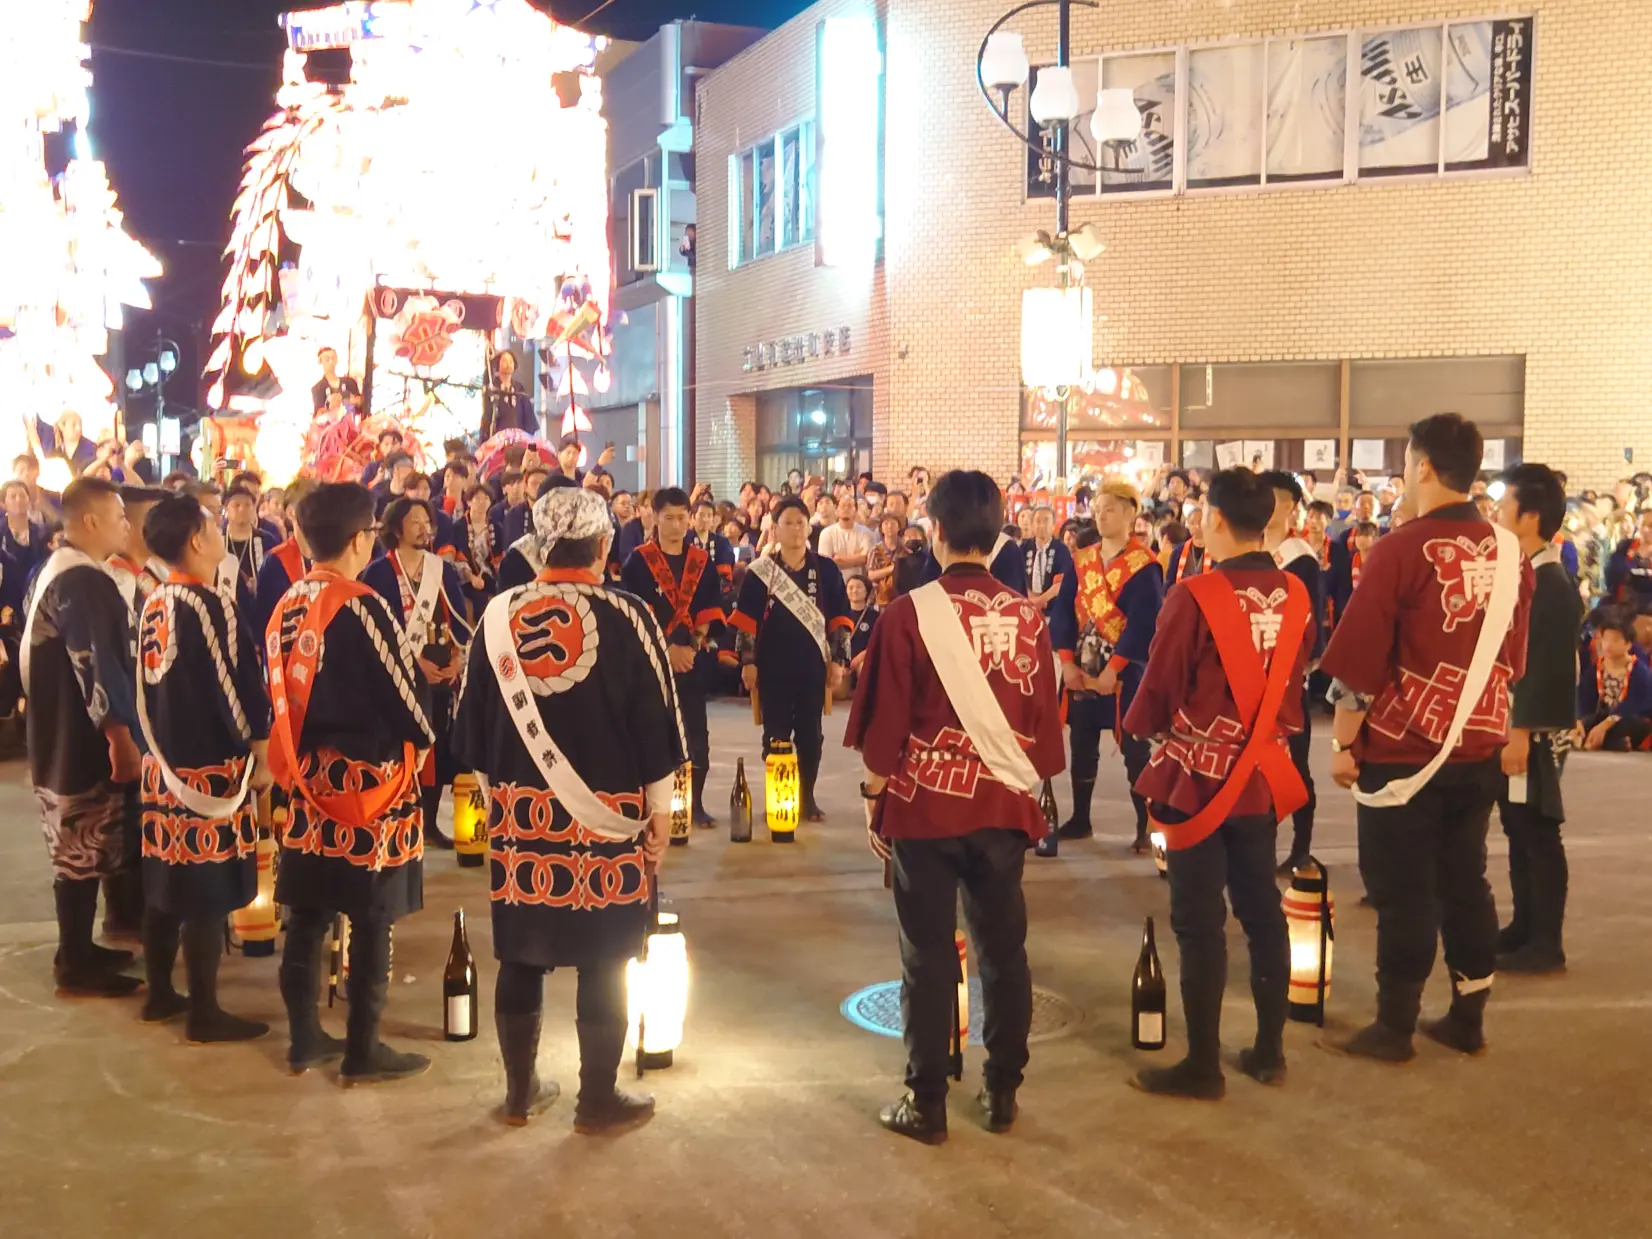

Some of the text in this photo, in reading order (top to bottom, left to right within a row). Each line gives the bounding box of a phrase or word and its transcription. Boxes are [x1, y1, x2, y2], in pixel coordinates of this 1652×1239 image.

[1404, 55, 1429, 85] 生
[1504, 22, 1524, 154] アサヒスーパードライ
[968, 611, 1018, 663] 南
